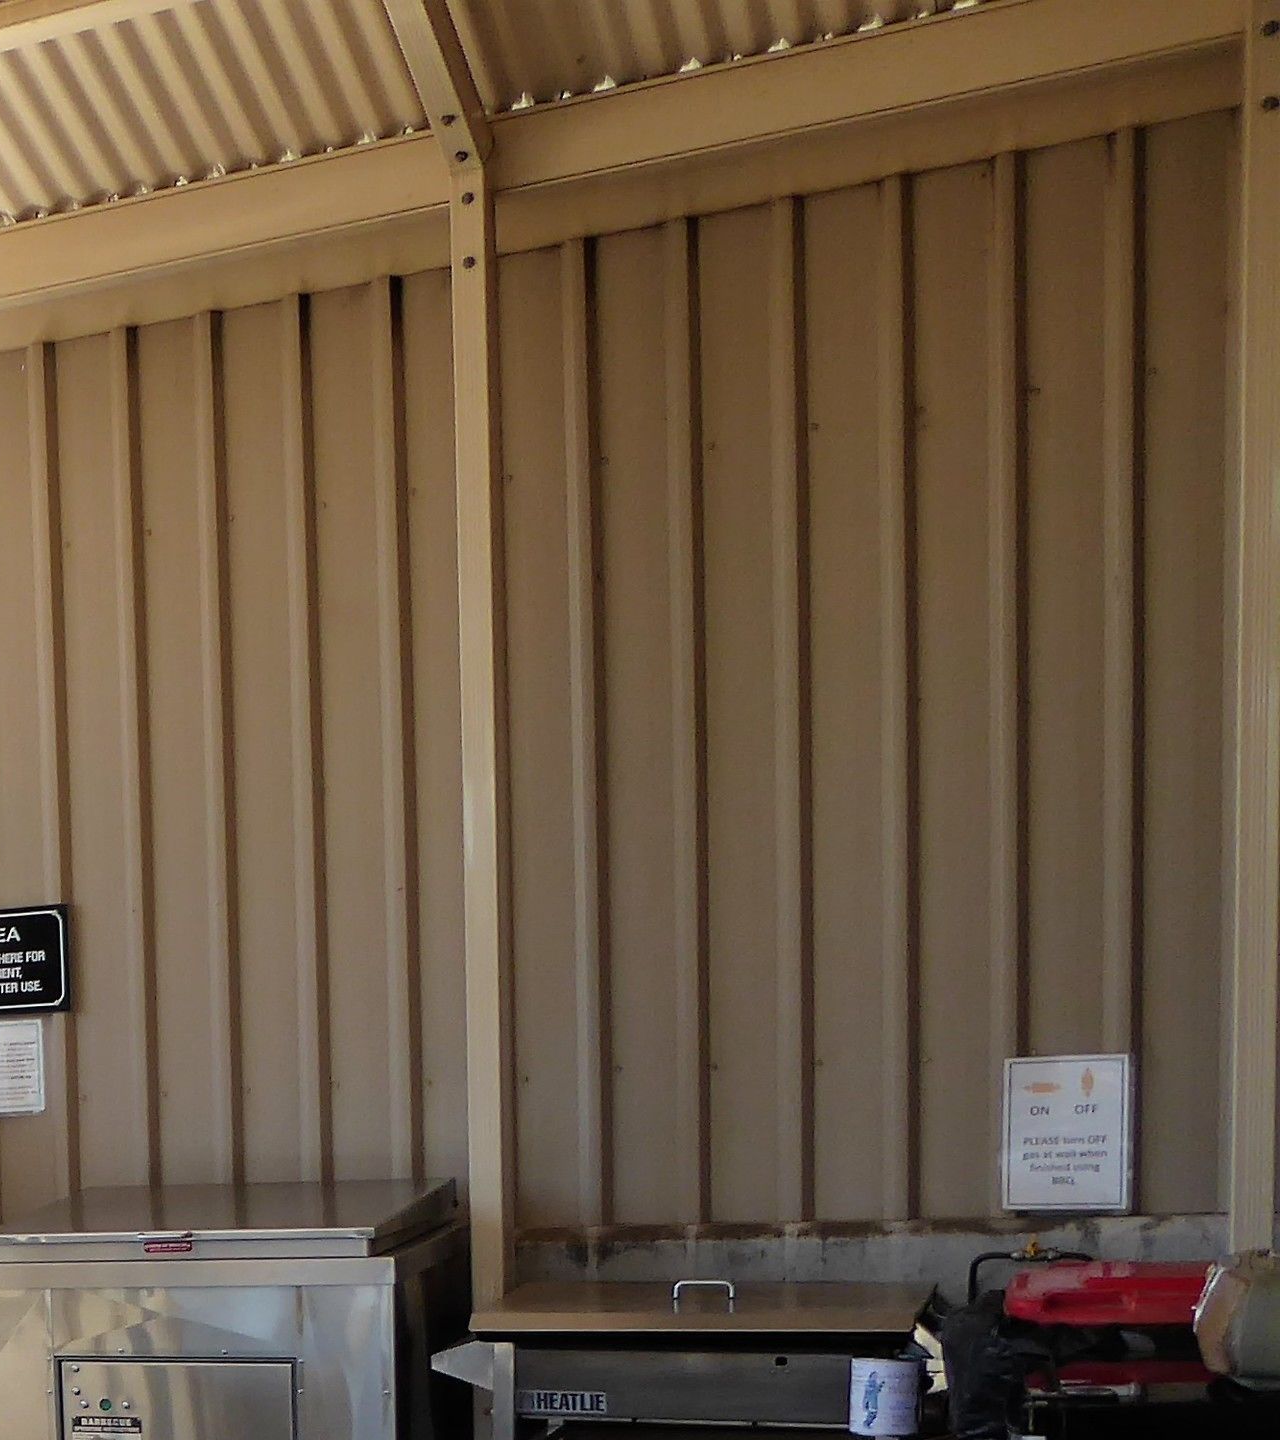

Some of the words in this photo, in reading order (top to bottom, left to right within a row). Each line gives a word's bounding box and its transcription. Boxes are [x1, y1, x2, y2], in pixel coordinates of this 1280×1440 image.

[25, 950, 46, 962] FOR
[1029, 1105, 1050, 1116] ON
[1074, 1104, 1098, 1115] OFF
[536, 1392, 605, 1411] HEATLIE
